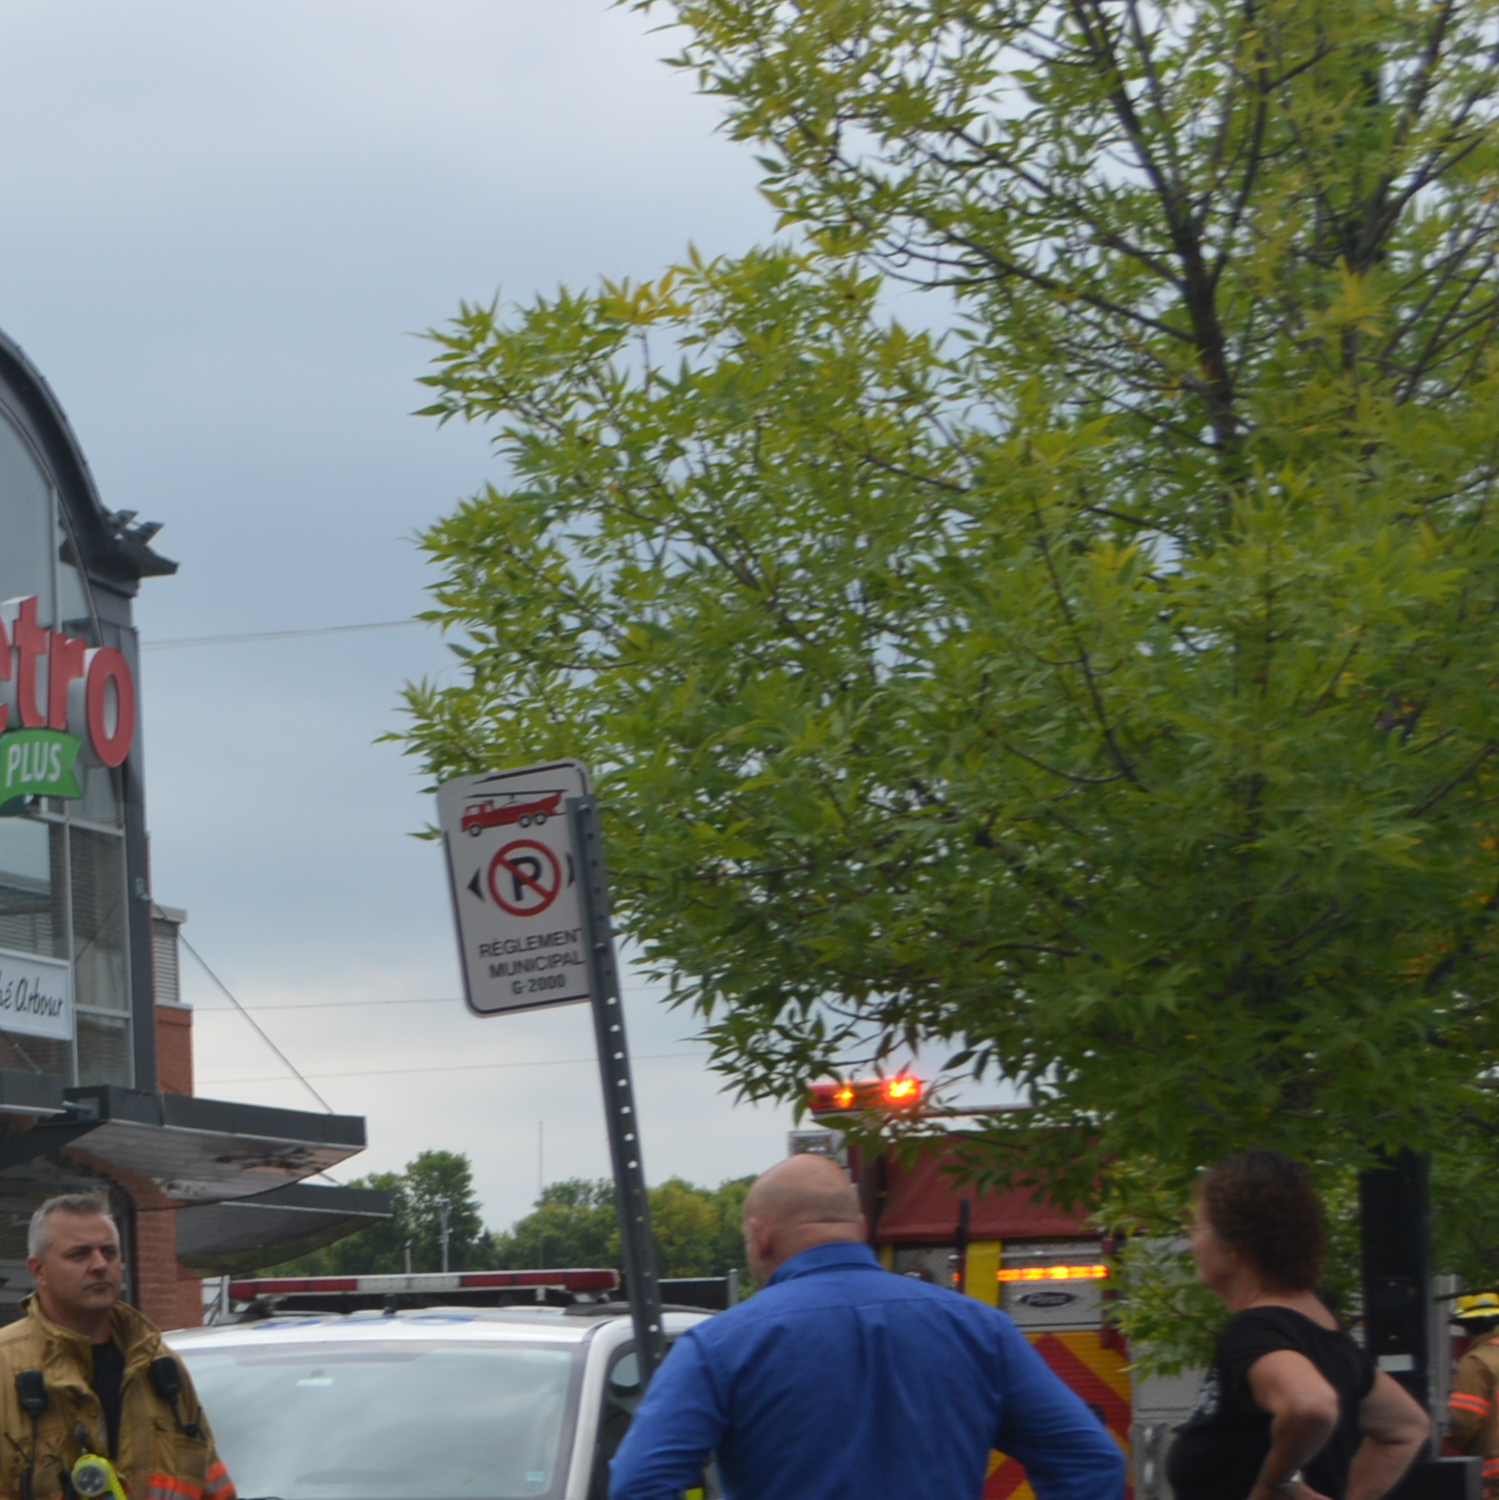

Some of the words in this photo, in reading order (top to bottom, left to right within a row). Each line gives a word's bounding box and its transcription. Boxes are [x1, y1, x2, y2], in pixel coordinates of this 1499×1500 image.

[5, 741, 63, 789] PLUS
[490, 952, 585, 978] MUNICIPAL
[512, 974, 566, 995] G-2000
